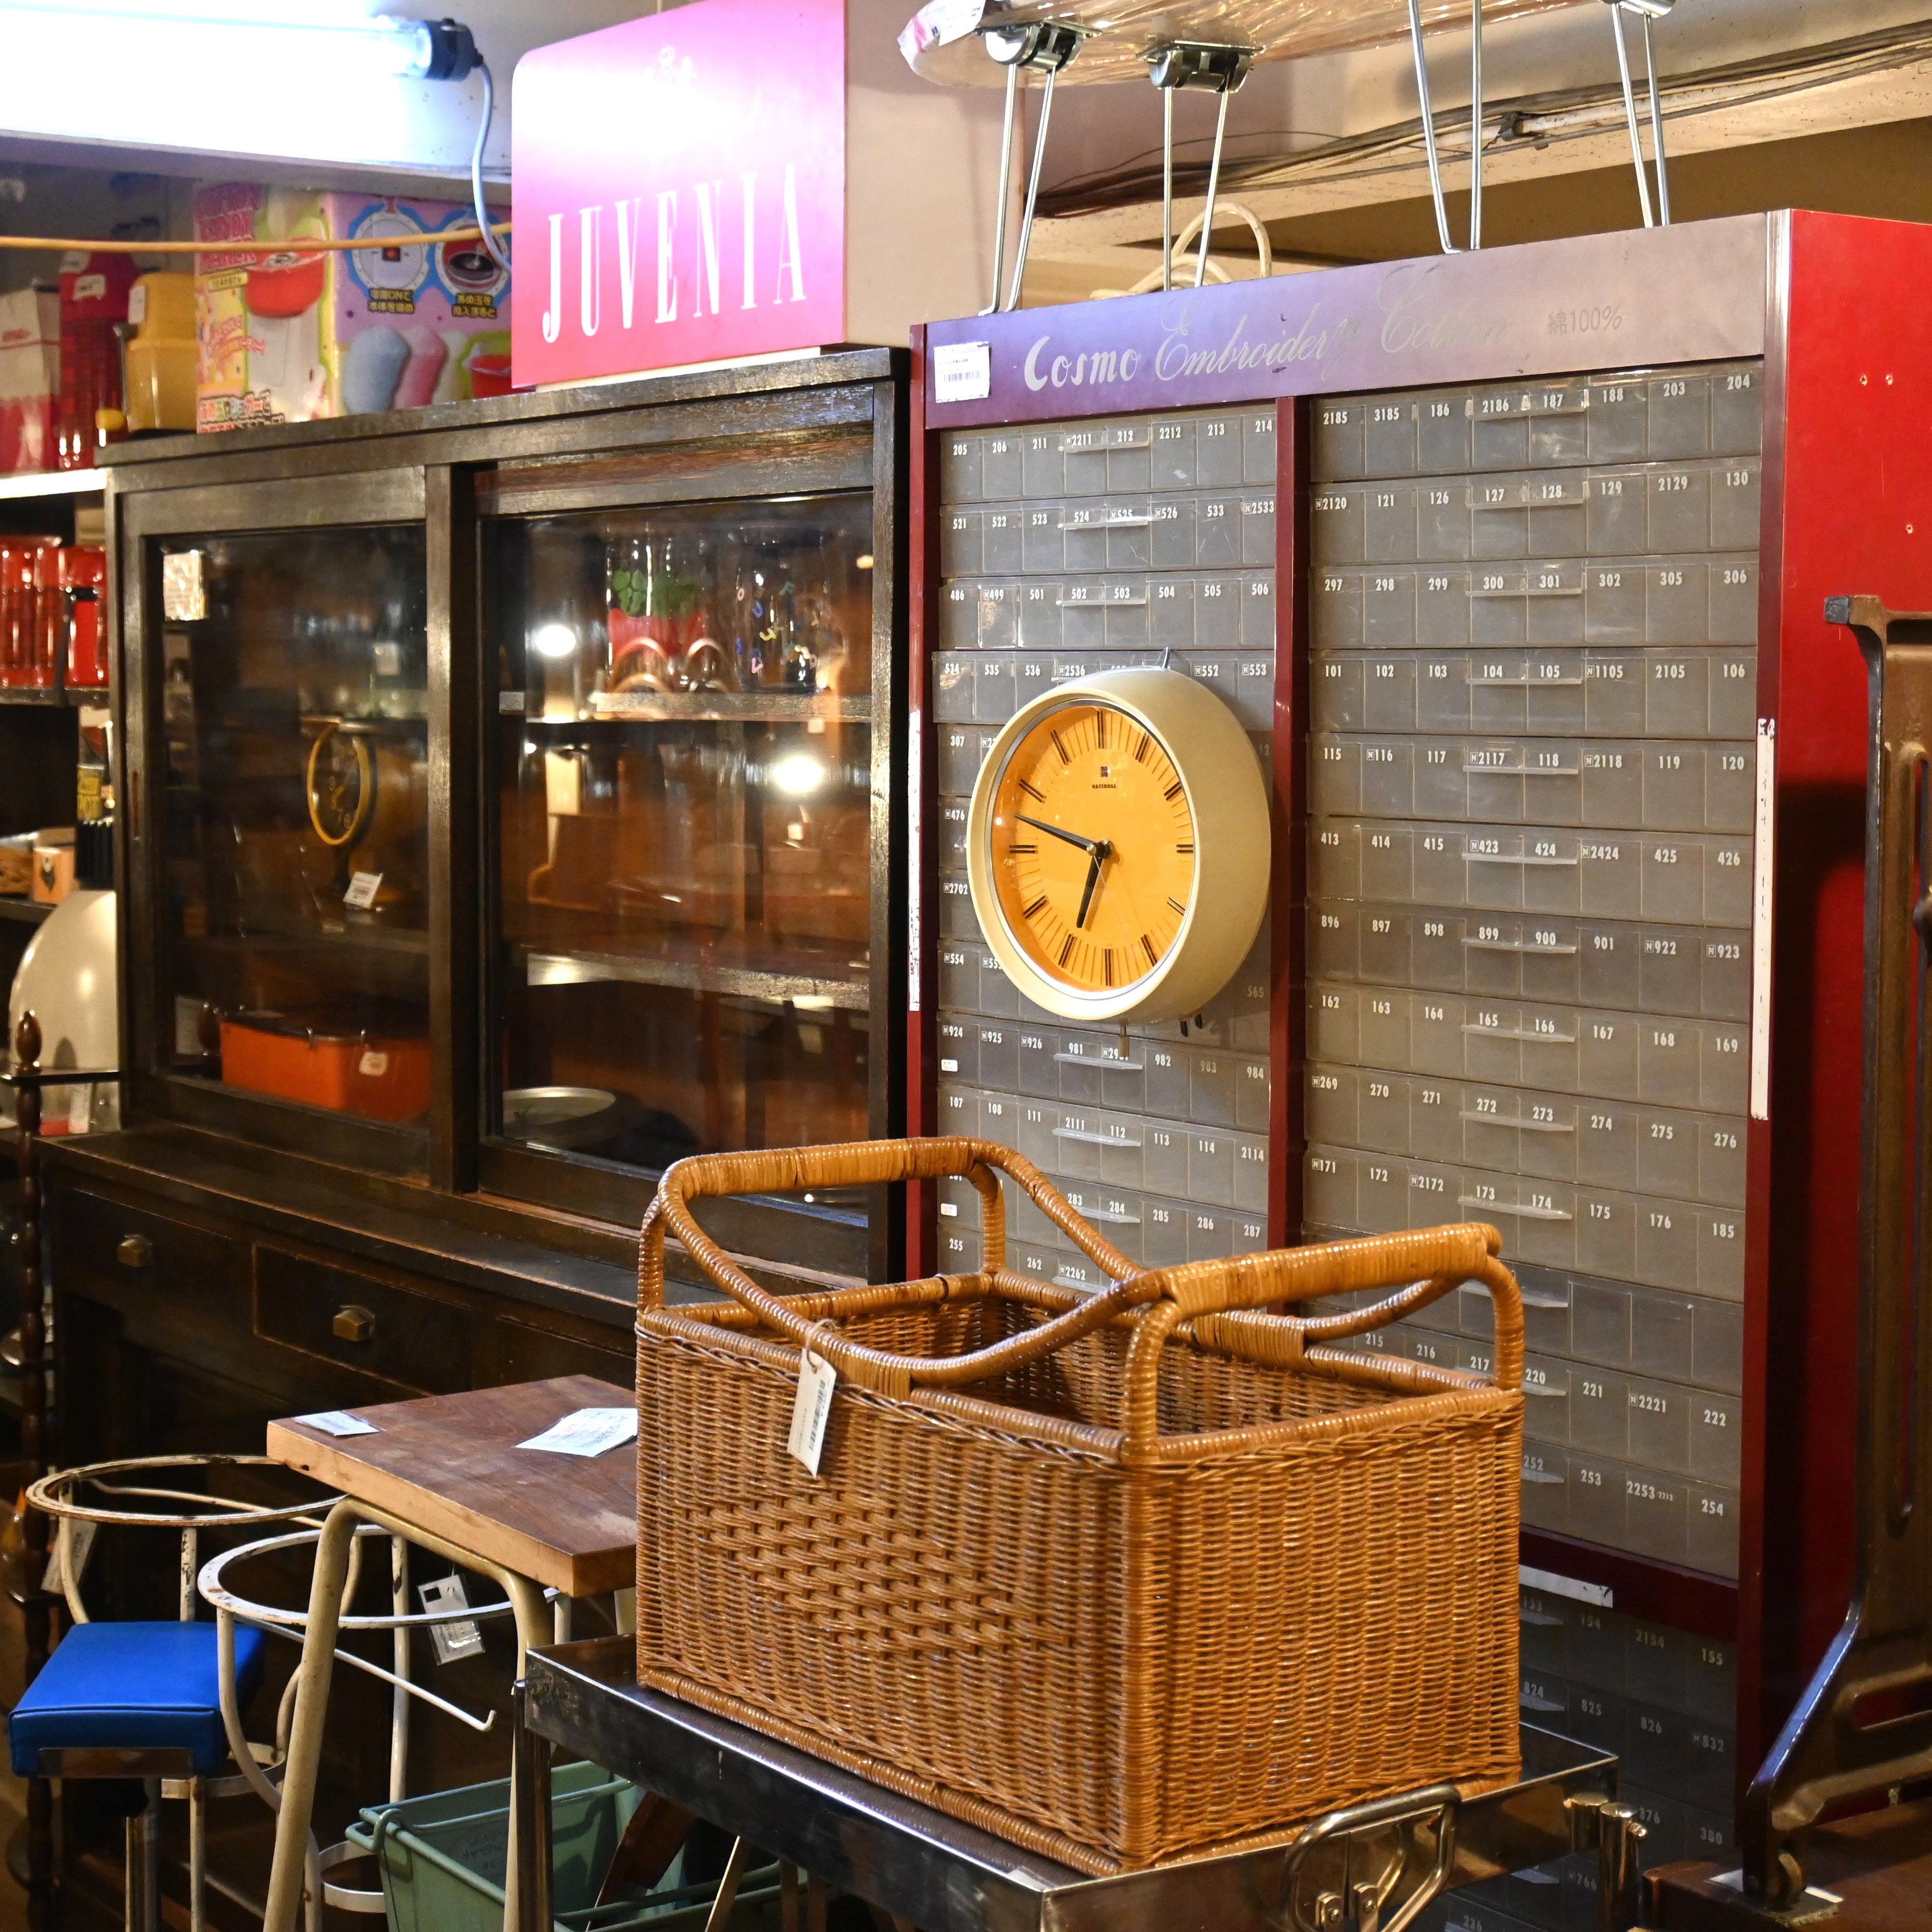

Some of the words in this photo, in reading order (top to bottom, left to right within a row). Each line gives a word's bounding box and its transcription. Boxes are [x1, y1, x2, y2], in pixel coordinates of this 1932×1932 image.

[542, 163, 807, 344] JUVENIA
[1024, 336, 1141, 391] Cosmo
[1155, 295, 1362, 382] Embroidery
[1324, 411, 1348, 425] 2185
[1375, 408, 1400, 422] 3185
[1431, 404, 1450, 417] 186
[1482, 399, 1509, 413] 2186
[1544, 393, 1563, 409] 187
[1603, 388, 1623, 402] 188
[1663, 382, 1685, 397] 203
[1727, 374, 1750, 390] 204
[954, 444, 967, 455] 205
[993, 442, 1007, 453] 206
[1033, 437, 1047, 449] 211
[1117, 430, 1133, 442] 212
[1160, 426, 1181, 439] 2212
[1208, 423, 1225, 436] 213
[1255, 420, 1272, 433] 214
[1378, 494, 1394, 507] 121
[1430, 491, 1449, 504] 126
[1485, 488, 1504, 502] 127
[1543, 485, 1562, 499] 128
[1601, 481, 1622, 495] 129
[1658, 476, 1688, 491] 2129
[1726, 471, 1748, 486] 130
[953, 518, 966, 529] 521
[993, 516, 1006, 527] 522
[1033, 513, 1047, 525] 523
[1074, 511, 1089, 523] 524
[1208, 504, 1224, 517] 533
[951, 590, 964, 601] 486
[1030, 589, 1044, 600] 501
[1072, 588, 1086, 599] 502
[1114, 587, 1130, 599] 503
[1159, 586, 1175, 598] 504
[1204, 585, 1221, 596] 505
[1252, 583, 1268, 595] 506
[1325, 579, 1342, 591] 297
[1376, 579, 1394, 591] 298
[1428, 578, 1447, 590] 299
[1483, 576, 1503, 589] 300
[1540, 575, 1559, 588] 301
[1599, 574, 1620, 587] 302
[1660, 571, 1682, 586] 305
[1724, 570, 1747, 584] 306
[945, 663, 959, 675] 534
[985, 664, 999, 676] 535
[1025, 665, 1040, 676] 536
[1326, 665, 1341, 677] 101
[1377, 665, 1394, 677] 102
[1429, 665, 1447, 678] 103
[1484, 665, 1503, 678] 104
[1540, 665, 1560, 678] 105
[1656, 665, 1685, 678] 2105
[1723, 664, 1745, 678] 106
[950, 736, 964, 746] 307
[1324, 747, 1341, 760] 115
[1428, 751, 1446, 763] 117
[1539, 753, 1559, 767] 118
[1659, 756, 1680, 769] 119
[1722, 756, 1744, 770] 120
[1321, 832, 1339, 845] 413
[1371, 835, 1390, 848] 414
[1424, 838, 1444, 851] 415
[1535, 841, 1556, 857] 424
[1655, 849, 1676, 863] 425
[1718, 852, 1740, 866] 426
[1321, 915, 1339, 928] 896
[1372, 920, 1390, 932] 897
[1425, 923, 1444, 936] 898
[1479, 926, 1498, 940] 899
[1535, 931, 1556, 945] 900
[1594, 936, 1613, 950] 901
[1323, 995, 1339, 1008] 162
[1372, 1001, 1390, 1014] 163
[1425, 1007, 1443, 1020] 164
[1479, 1012, 1498, 1027] 165
[1535, 1019, 1555, 1033] 166
[1594, 1025, 1613, 1040] 167
[1654, 1032, 1674, 1047] 168
[1716, 1038, 1738, 1052] 169
[1069, 1043, 1083, 1056] 981
[1155, 1054, 1171, 1066] 982
[1247, 1066, 1264, 1078] 984
[950, 1097, 963, 1108] 107
[988, 1103, 1002, 1115] 108
[1027, 1110, 1041, 1122] 111
[1065, 1117, 1085, 1130] 2111
[1111, 1125, 1125, 1138] 112
[1154, 1133, 1170, 1146] 113
[1199, 1140, 1215, 1153] 114
[1241, 1147, 1264, 1161] 2114
[1370, 1084, 1389, 1098] 270
[1422, 1090, 1440, 1104] 271
[1477, 1098, 1496, 1113] 272
[1533, 1106, 1553, 1122] 273
[1591, 1115, 1612, 1130] 274
[1651, 1124, 1673, 1139] 275
[1714, 1133, 1737, 1148] 276
[1068, 1193, 1082, 1208] 283
[1110, 1201, 1125, 1213] 284
[1153, 1209, 1168, 1223] 285
[1198, 1217, 1214, 1230] 286
[1244, 1225, 1260, 1237] 287
[1370, 1167, 1388, 1182] 172
[1477, 1185, 1495, 1200] 173
[1532, 1194, 1552, 1212] 174
[1590, 1204, 1610, 1219] 175
[1650, 1214, 1671, 1229] 176
[1713, 1223, 1734, 1238] 185
[949, 1238, 963, 1251] 255
[1027, 1257, 1041, 1270] 262
[1365, 1332, 1383, 1347] 215
[1417, 1344, 1435, 1359] 216
[1470, 1356, 1490, 1371] 217
[1526, 1368, 1546, 1384] 220
[1583, 1382, 1603, 1398] 221
[1704, 1409, 1726, 1427] 222
[1523, 1455, 1543, 1471] 252
[1581, 1469, 1601, 1486] 253
[1626, 1481, 1655, 1499] 2253
[1701, 1499, 1723, 1516] 254
[1523, 1682, 1544, 1698] 824
[1581, 1699, 1602, 1716] 825
